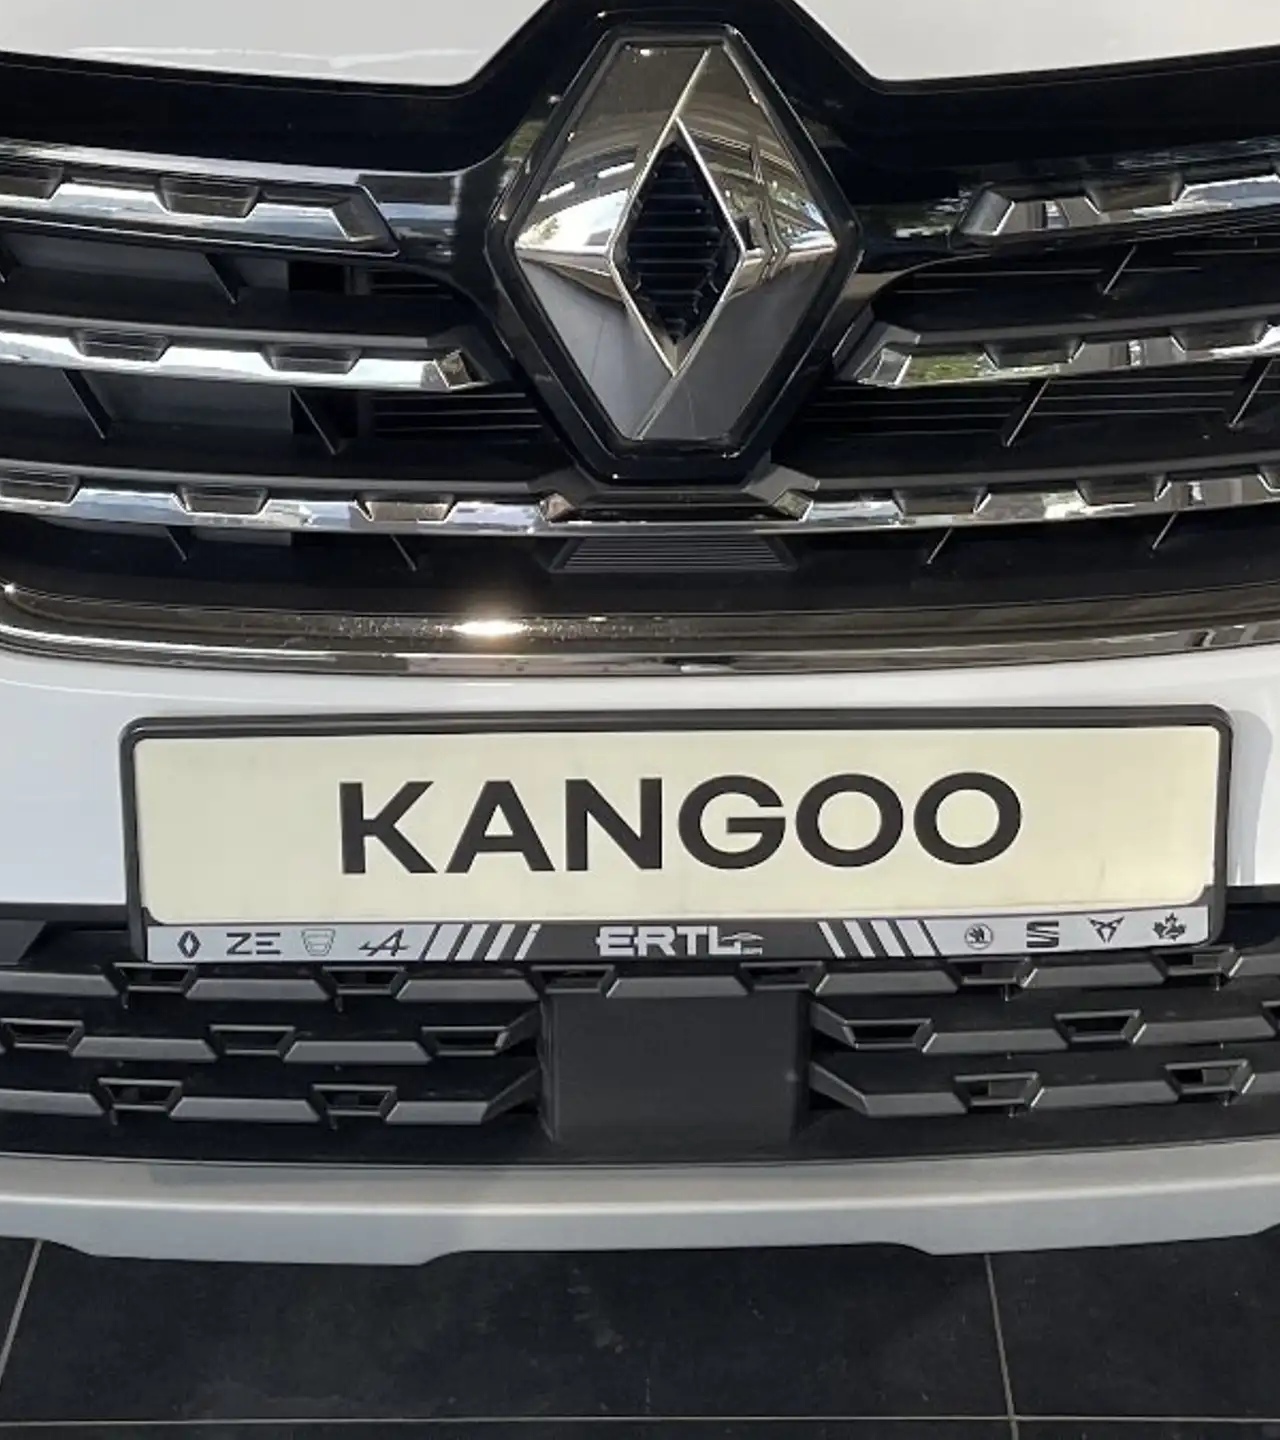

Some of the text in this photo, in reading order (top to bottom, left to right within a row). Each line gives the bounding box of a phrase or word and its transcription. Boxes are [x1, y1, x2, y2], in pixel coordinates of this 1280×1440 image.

[338, 771, 1023, 874] KANGOO
[225, 931, 282, 956] ZE
[596, 925, 742, 957] ERTL
